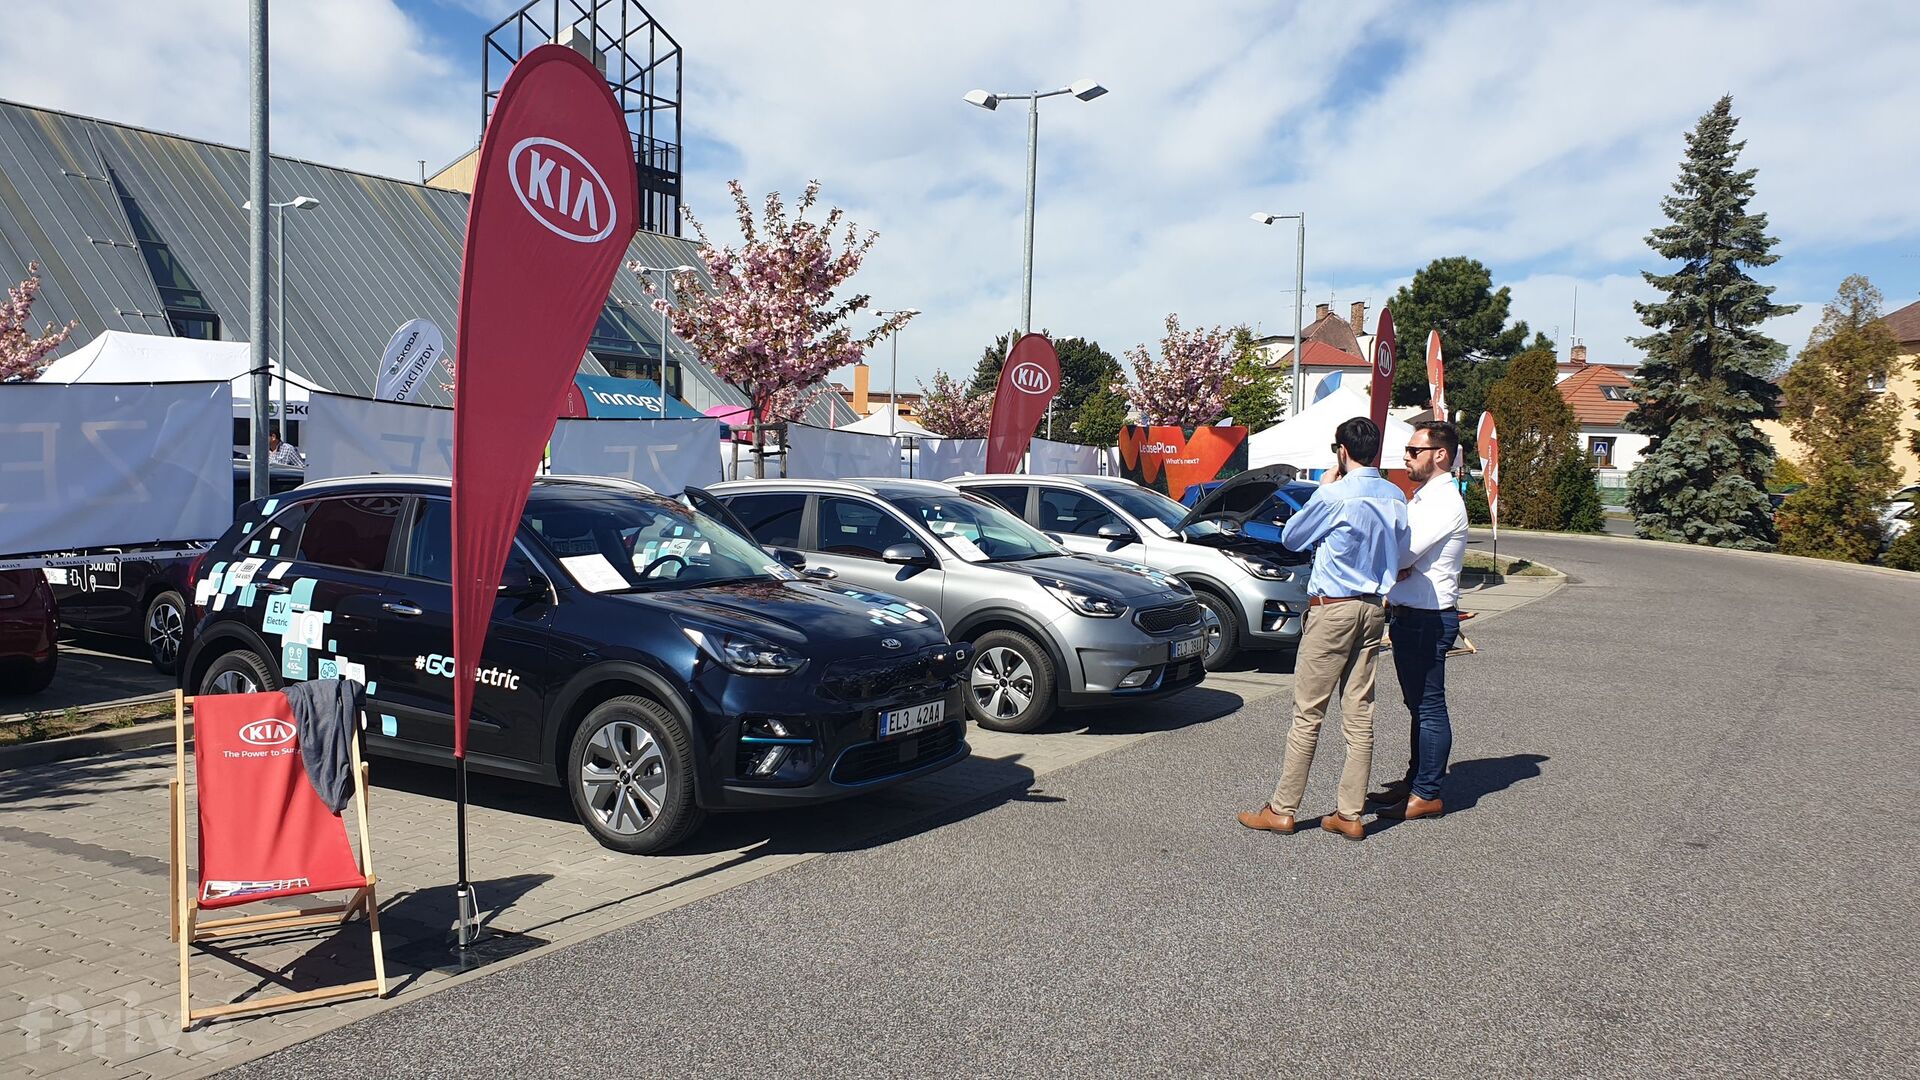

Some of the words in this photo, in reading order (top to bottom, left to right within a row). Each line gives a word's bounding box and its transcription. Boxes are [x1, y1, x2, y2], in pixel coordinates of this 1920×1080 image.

[528, 149, 599, 232] KIA
[396, 331, 420, 363] ŠKODA
[1379, 347, 1390, 370] KIA
[394, 369, 419, 402] OVACÍ
[1018, 367, 1044, 390] KIA
[1139, 441, 1177, 454] LeasePlan
[273, 601, 287, 615] EV
[266, 616, 288, 627] Electric
[889, 710, 910, 732] EL3
[916, 703, 940, 726] 42AA
[249, 724, 288, 741] KIA
[223, 750, 240, 758] The
[241, 749, 268, 758] Power
